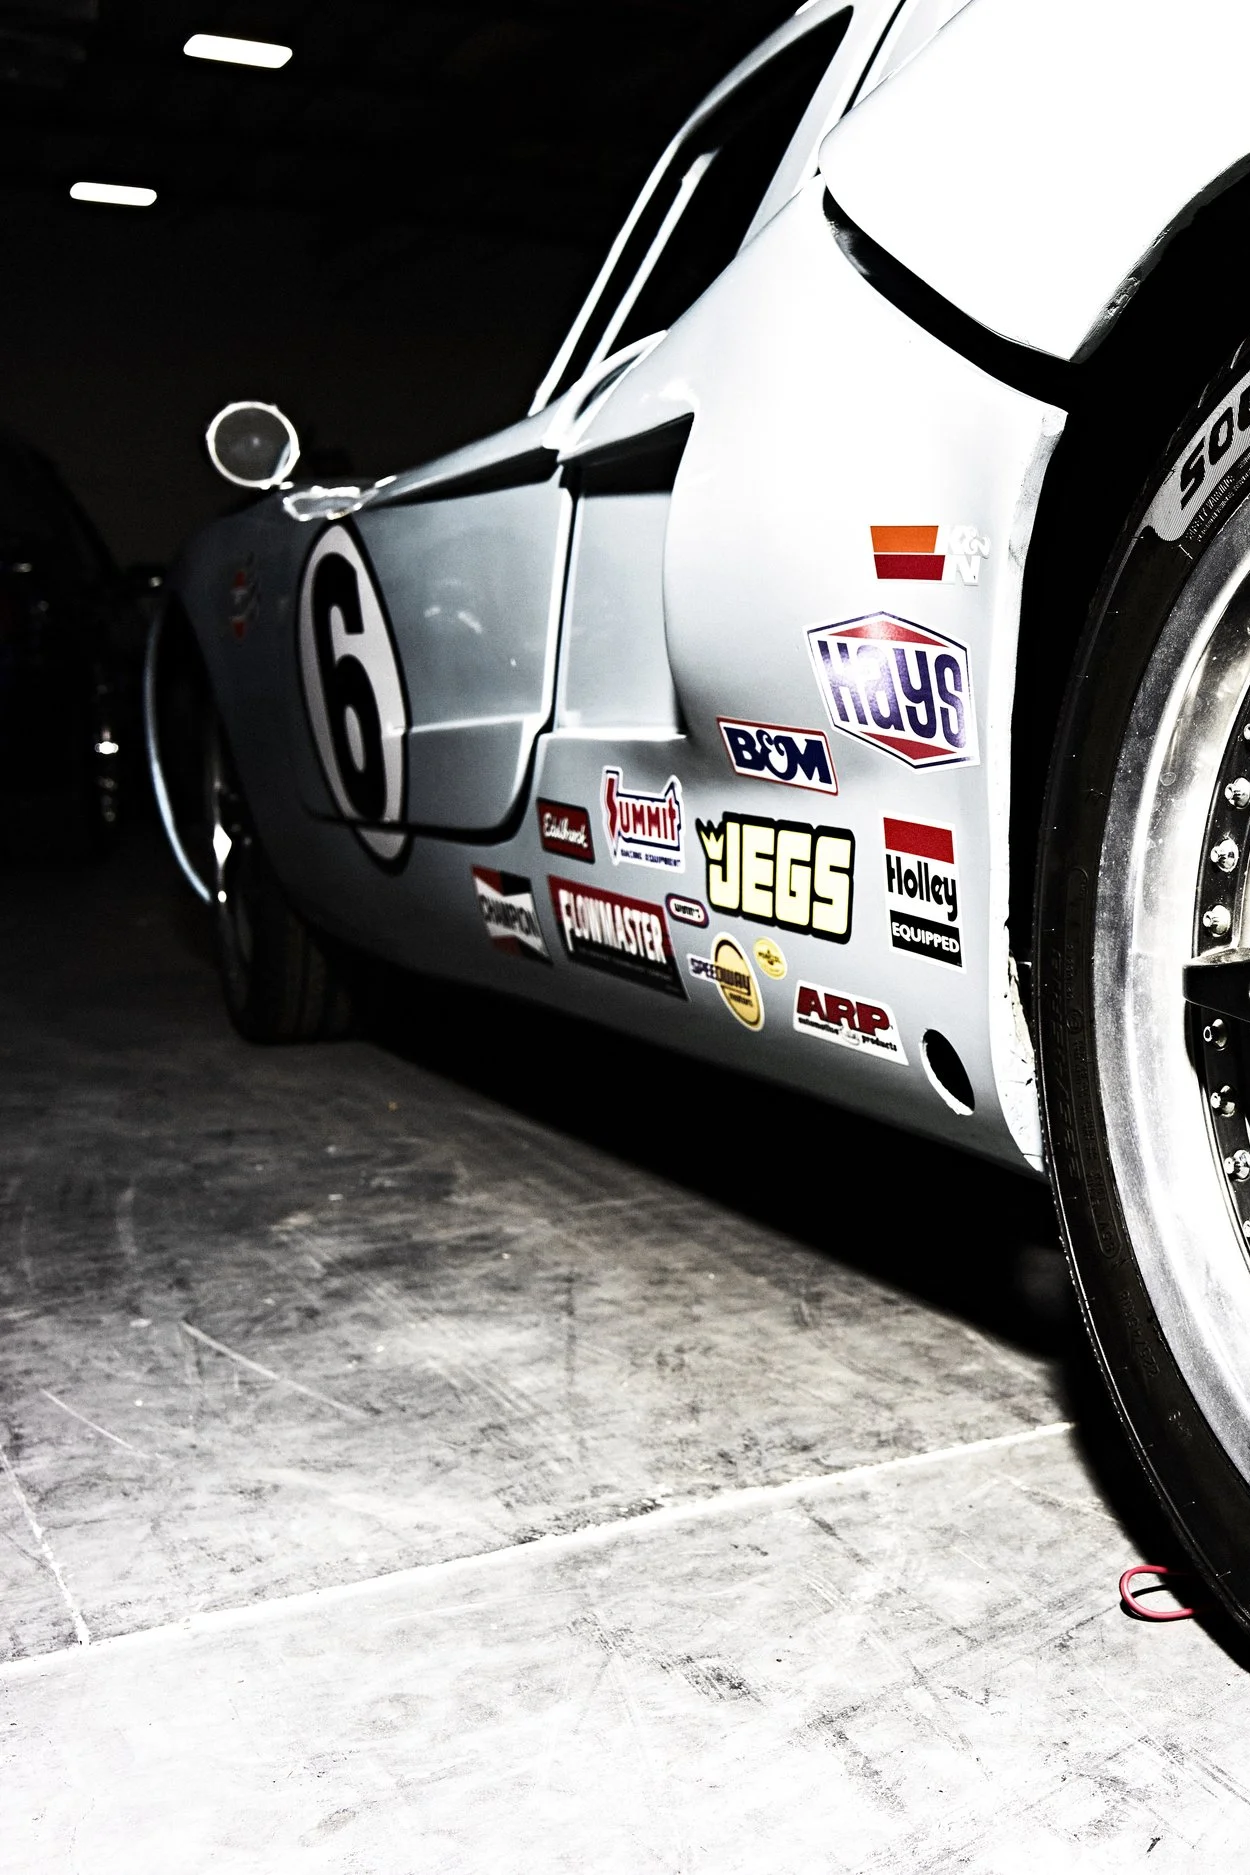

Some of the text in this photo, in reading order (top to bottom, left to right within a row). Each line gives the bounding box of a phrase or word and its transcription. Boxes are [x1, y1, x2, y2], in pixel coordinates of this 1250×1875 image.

[312, 552, 388, 820] 6
[817, 639, 967, 749] Hays
[723, 726, 833, 784] B&M
[703, 818, 853, 937] JEGS
[885, 853, 958, 922] Holley
[558, 888, 667, 965] FLOWMASTER
[891, 921, 960, 953] EQUIPPED
[690, 957, 751, 996] SPEEDWAY
[797, 985, 890, 1036] ARP
